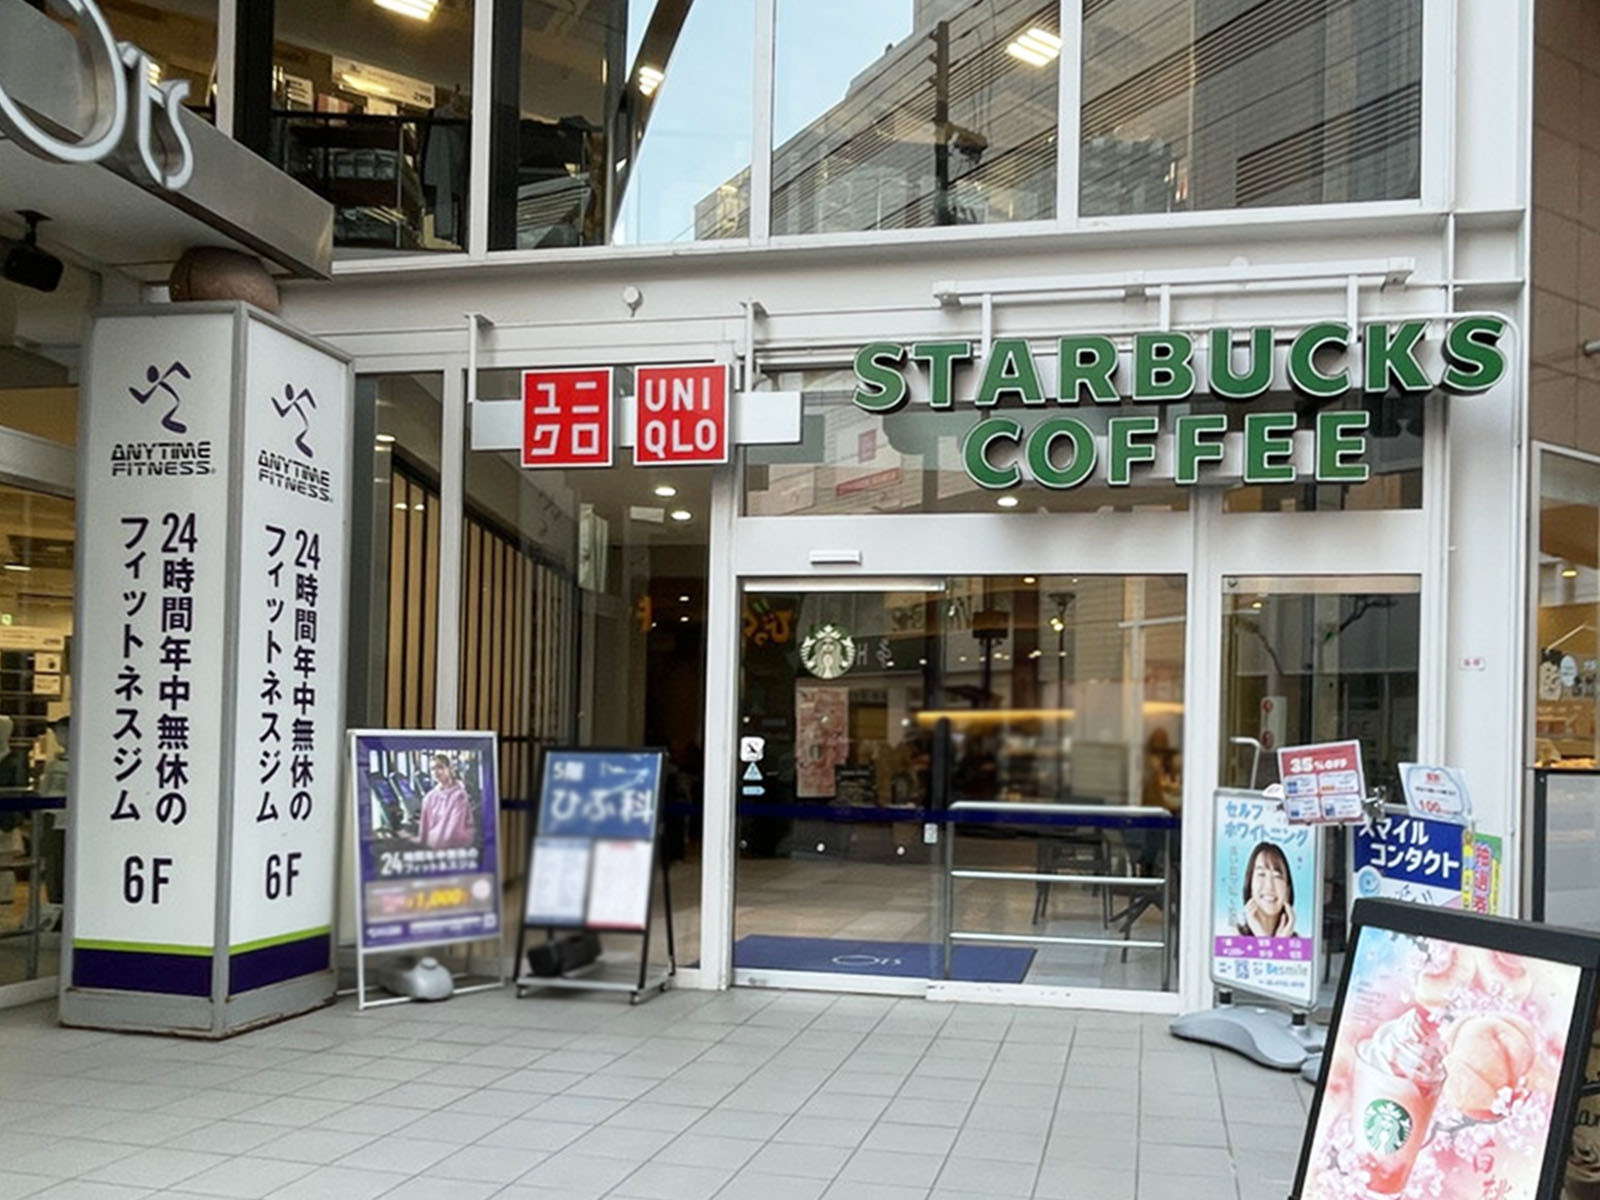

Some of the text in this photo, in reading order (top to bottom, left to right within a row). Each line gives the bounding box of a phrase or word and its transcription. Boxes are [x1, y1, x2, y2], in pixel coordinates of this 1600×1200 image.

[852, 315, 1507, 412] STARBUCKS
[533, 380, 600, 416] ユニ
[645, 376, 711, 412] UNI
[111, 441, 211, 461] ANYTIME
[530, 422, 600, 457] クロ
[644, 418, 718, 460] QLO
[961, 410, 1370, 490] COFFEE
[112, 461, 210, 477] FITNESS
[258, 449, 330, 488] ANYTIME
[258, 468, 331, 502] FITNESS
[110, 516, 150, 821] フィットネスジム
[155, 512, 198, 826] 24時間年中無休の
[256, 524, 287, 823] フィットネスジム
[289, 529, 321, 822] 24時間年中無休の
[551, 788, 654, 824] ひふ科
[1225, 801, 1264, 821] セルフ
[1224, 821, 1309, 847] ホワイトニング
[1358, 818, 1430, 845] スマイル
[265, 852, 302, 900] 6F
[1370, 843, 1460, 878] コンタクト
[123, 855, 173, 905] 6F
